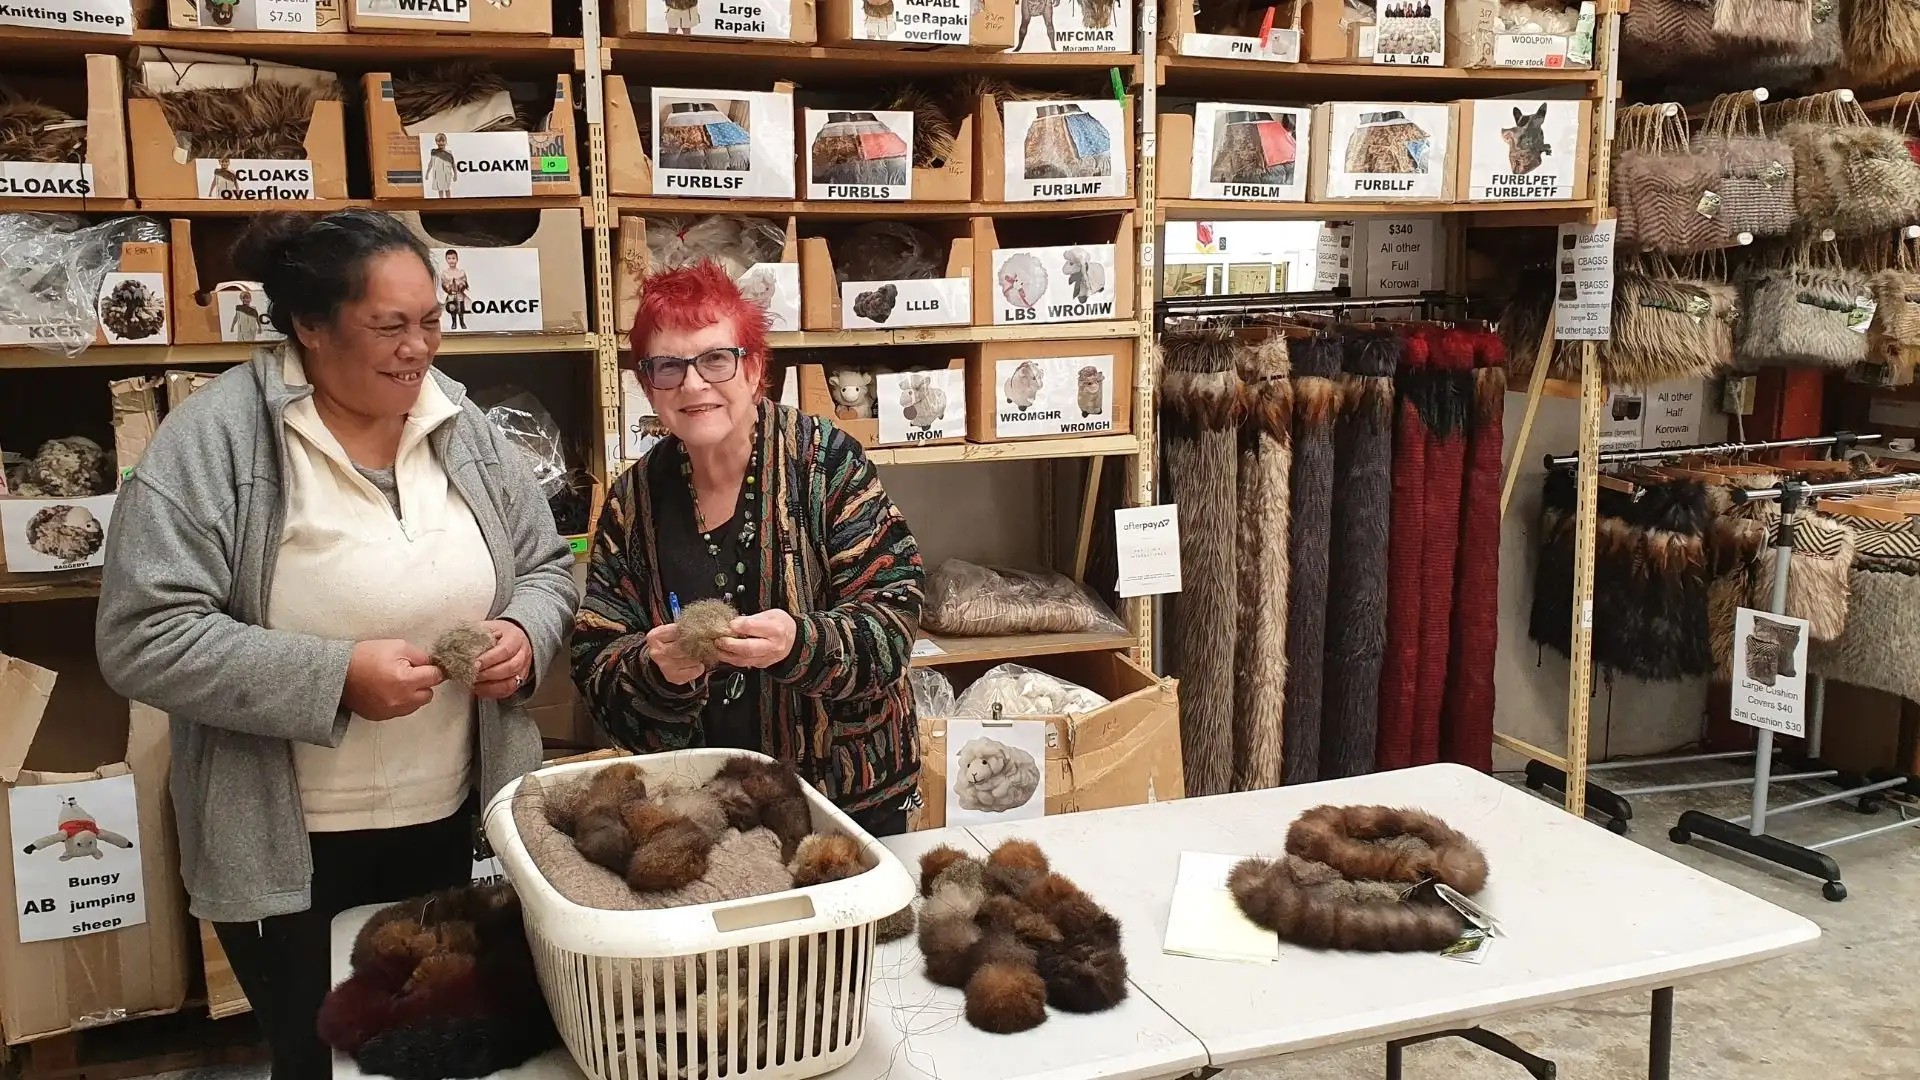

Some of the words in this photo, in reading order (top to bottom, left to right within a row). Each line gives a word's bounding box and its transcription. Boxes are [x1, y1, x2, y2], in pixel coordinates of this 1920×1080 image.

[0, 5, 67, 23] Knitting
[73, 10, 125, 27] Sheep
[269, 10, 302, 23] $7.50
[719, 3, 762, 18] Large
[895, 11, 920, 26] Lge
[922, 12, 968, 27] Rapaki
[714, 19, 765, 33] Rapaki
[904, 29, 962, 42] overflow
[1056, 31, 1114, 42] MFCMAR
[1511, 35, 1553, 45] WOOLPOM
[1062, 44, 1094, 52] Marama
[1096, 44, 1116, 52] Maro
[1231, 41, 1253, 54] PIN
[1383, 54, 1396, 63] LA
[1410, 54, 1430, 65] LAR
[1525, 58, 1544, 66] stock
[456, 159, 529, 173] CLOAKM
[235, 168, 309, 183] CLOAKS
[1491, 174, 1557, 186] FURBLPET
[0, 177, 91, 196] CLOAKS
[666, 175, 744, 190] FURBLSF
[1354, 179, 1415, 192] FURBLLF
[220, 186, 309, 200] overflow
[828, 185, 890, 199] FURBLS
[1032, 182, 1102, 197] FURBLMF
[1223, 185, 1280, 198] FURBLM
[1485, 186, 1557, 198] FURBLPETF
[1388, 223, 1413, 235] $340
[1143, 246, 1153, 262] 8
[1380, 242, 1393, 253] All
[1395, 242, 1420, 253] other
[1391, 260, 1409, 271] Full
[1380, 278, 1420, 289] Korowai
[1580, 280, 1609, 290] PBAGSG
[445, 299, 540, 315] CLOAKCF
[905, 299, 940, 312] LLLB
[1004, 307, 1037, 322] LBS
[1047, 301, 1112, 319] WROMW
[1587, 312, 1598, 321] $25
[1565, 326, 1581, 335] other
[1583, 326, 1597, 337] bags
[1657, 392, 1669, 402] All
[1671, 391, 1693, 402] other
[1000, 410, 1061, 423] WROMGHR
[1665, 407, 1684, 417] Half
[1060, 420, 1111, 432] WROMGH
[1655, 424, 1689, 434] Korowai
[906, 430, 943, 441] WROM
[1123, 520, 1158, 531] afterpay
[1741, 680, 1764, 693] Large
[1765, 684, 1799, 701] Cushion
[1747, 695, 1775, 710] Covers
[1777, 702, 1793, 714] $40
[1734, 708, 1749, 720] Sml
[1750, 712, 1783, 729] Cushion
[1785, 720, 1802, 733] $30
[68, 872, 121, 888] Bungy
[23, 898, 57, 915] AB
[69, 892, 136, 914] jumping
[72, 916, 122, 933] sheep
